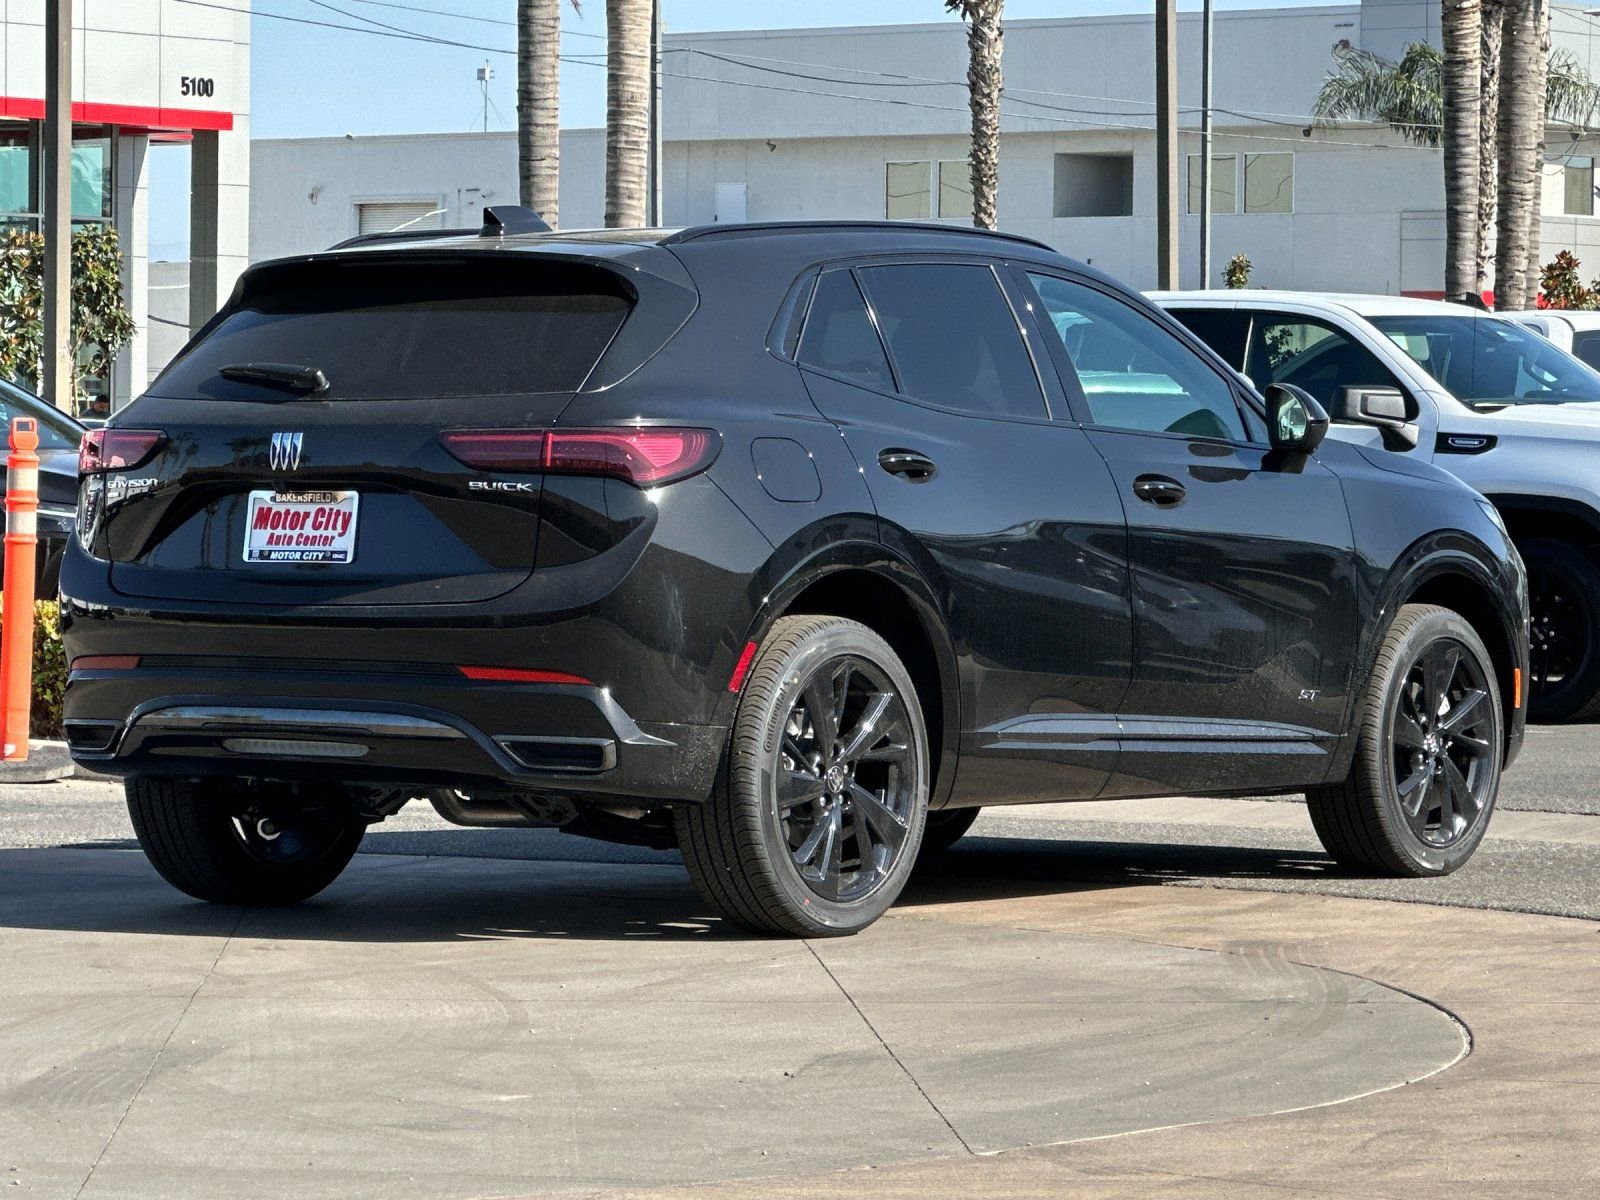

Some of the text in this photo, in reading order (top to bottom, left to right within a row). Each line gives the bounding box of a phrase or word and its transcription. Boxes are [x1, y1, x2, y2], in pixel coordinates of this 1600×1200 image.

[181, 76, 214, 98] 5100
[468, 481, 533, 492] BUICK
[275, 493, 332, 503] BAKERSFIELD
[253, 506, 353, 538] Motor City
[266, 532, 336, 547] Auto Center
[270, 551, 302, 560] MOTOR
[303, 551, 325, 560] CITY
[763, 687, 787, 753] Continental
